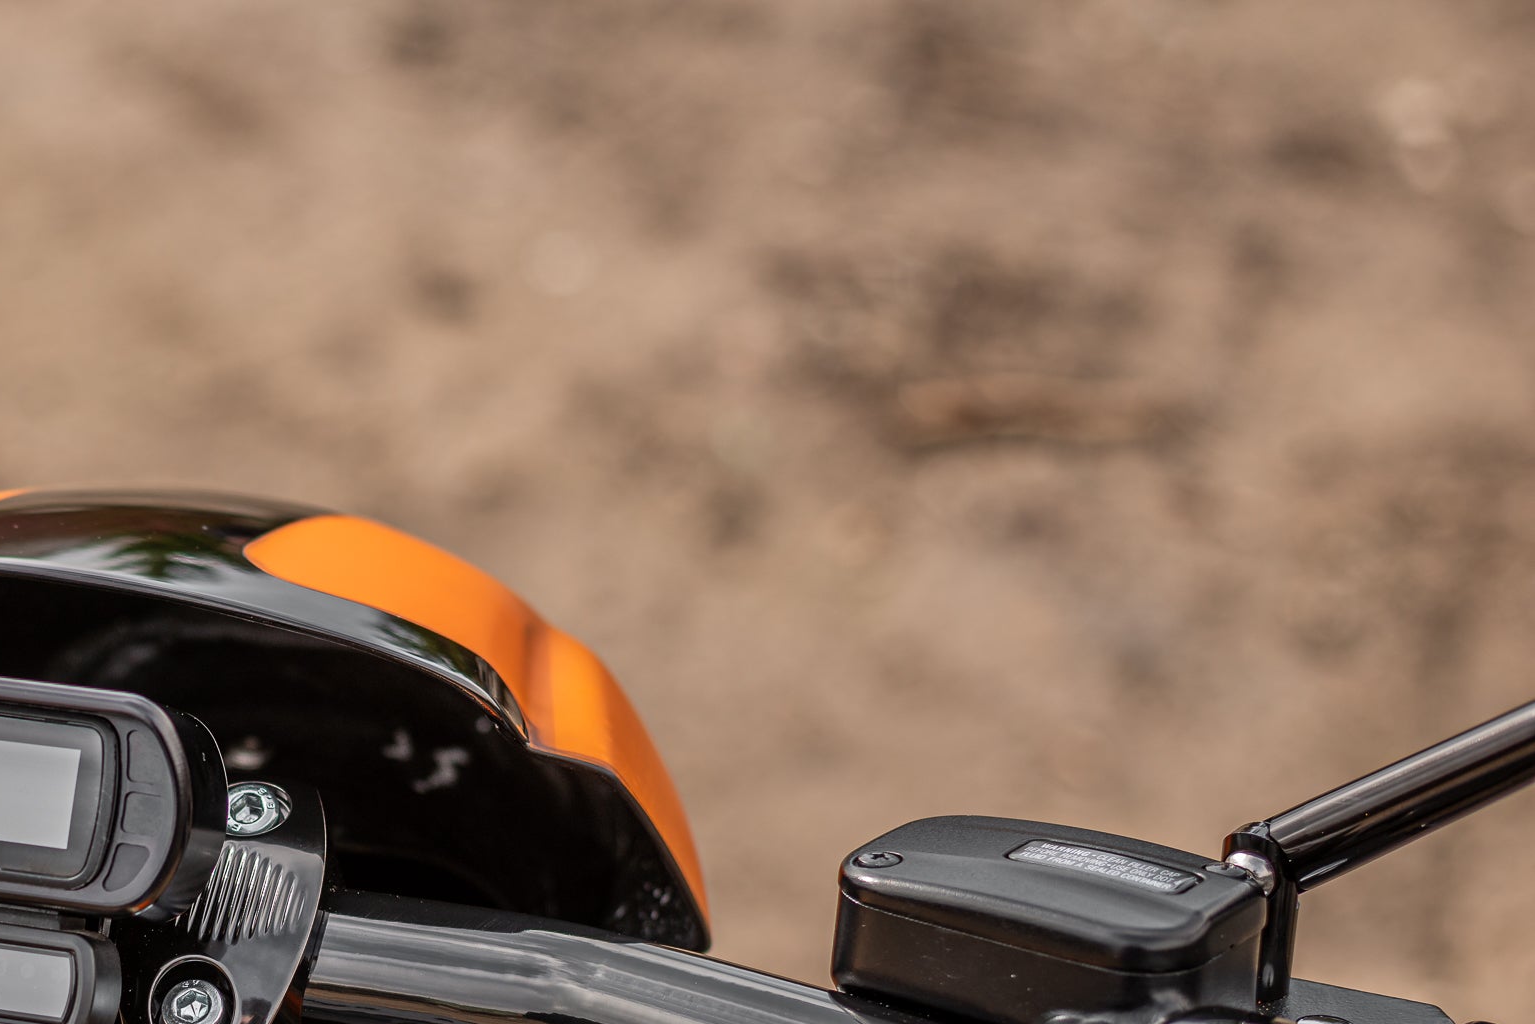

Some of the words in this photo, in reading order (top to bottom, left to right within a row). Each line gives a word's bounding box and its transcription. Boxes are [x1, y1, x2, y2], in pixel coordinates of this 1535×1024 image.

[1019, 850, 1047, 860] FLUID
[1046, 856, 1075, 867] FROM
[1084, 864, 1120, 877] SEALED
[1041, 842, 1092, 857] WARNING
[1096, 854, 1128, 865] CLEAN
[1127, 861, 1160, 873] FILLER
[1160, 869, 1181, 879] CAP
